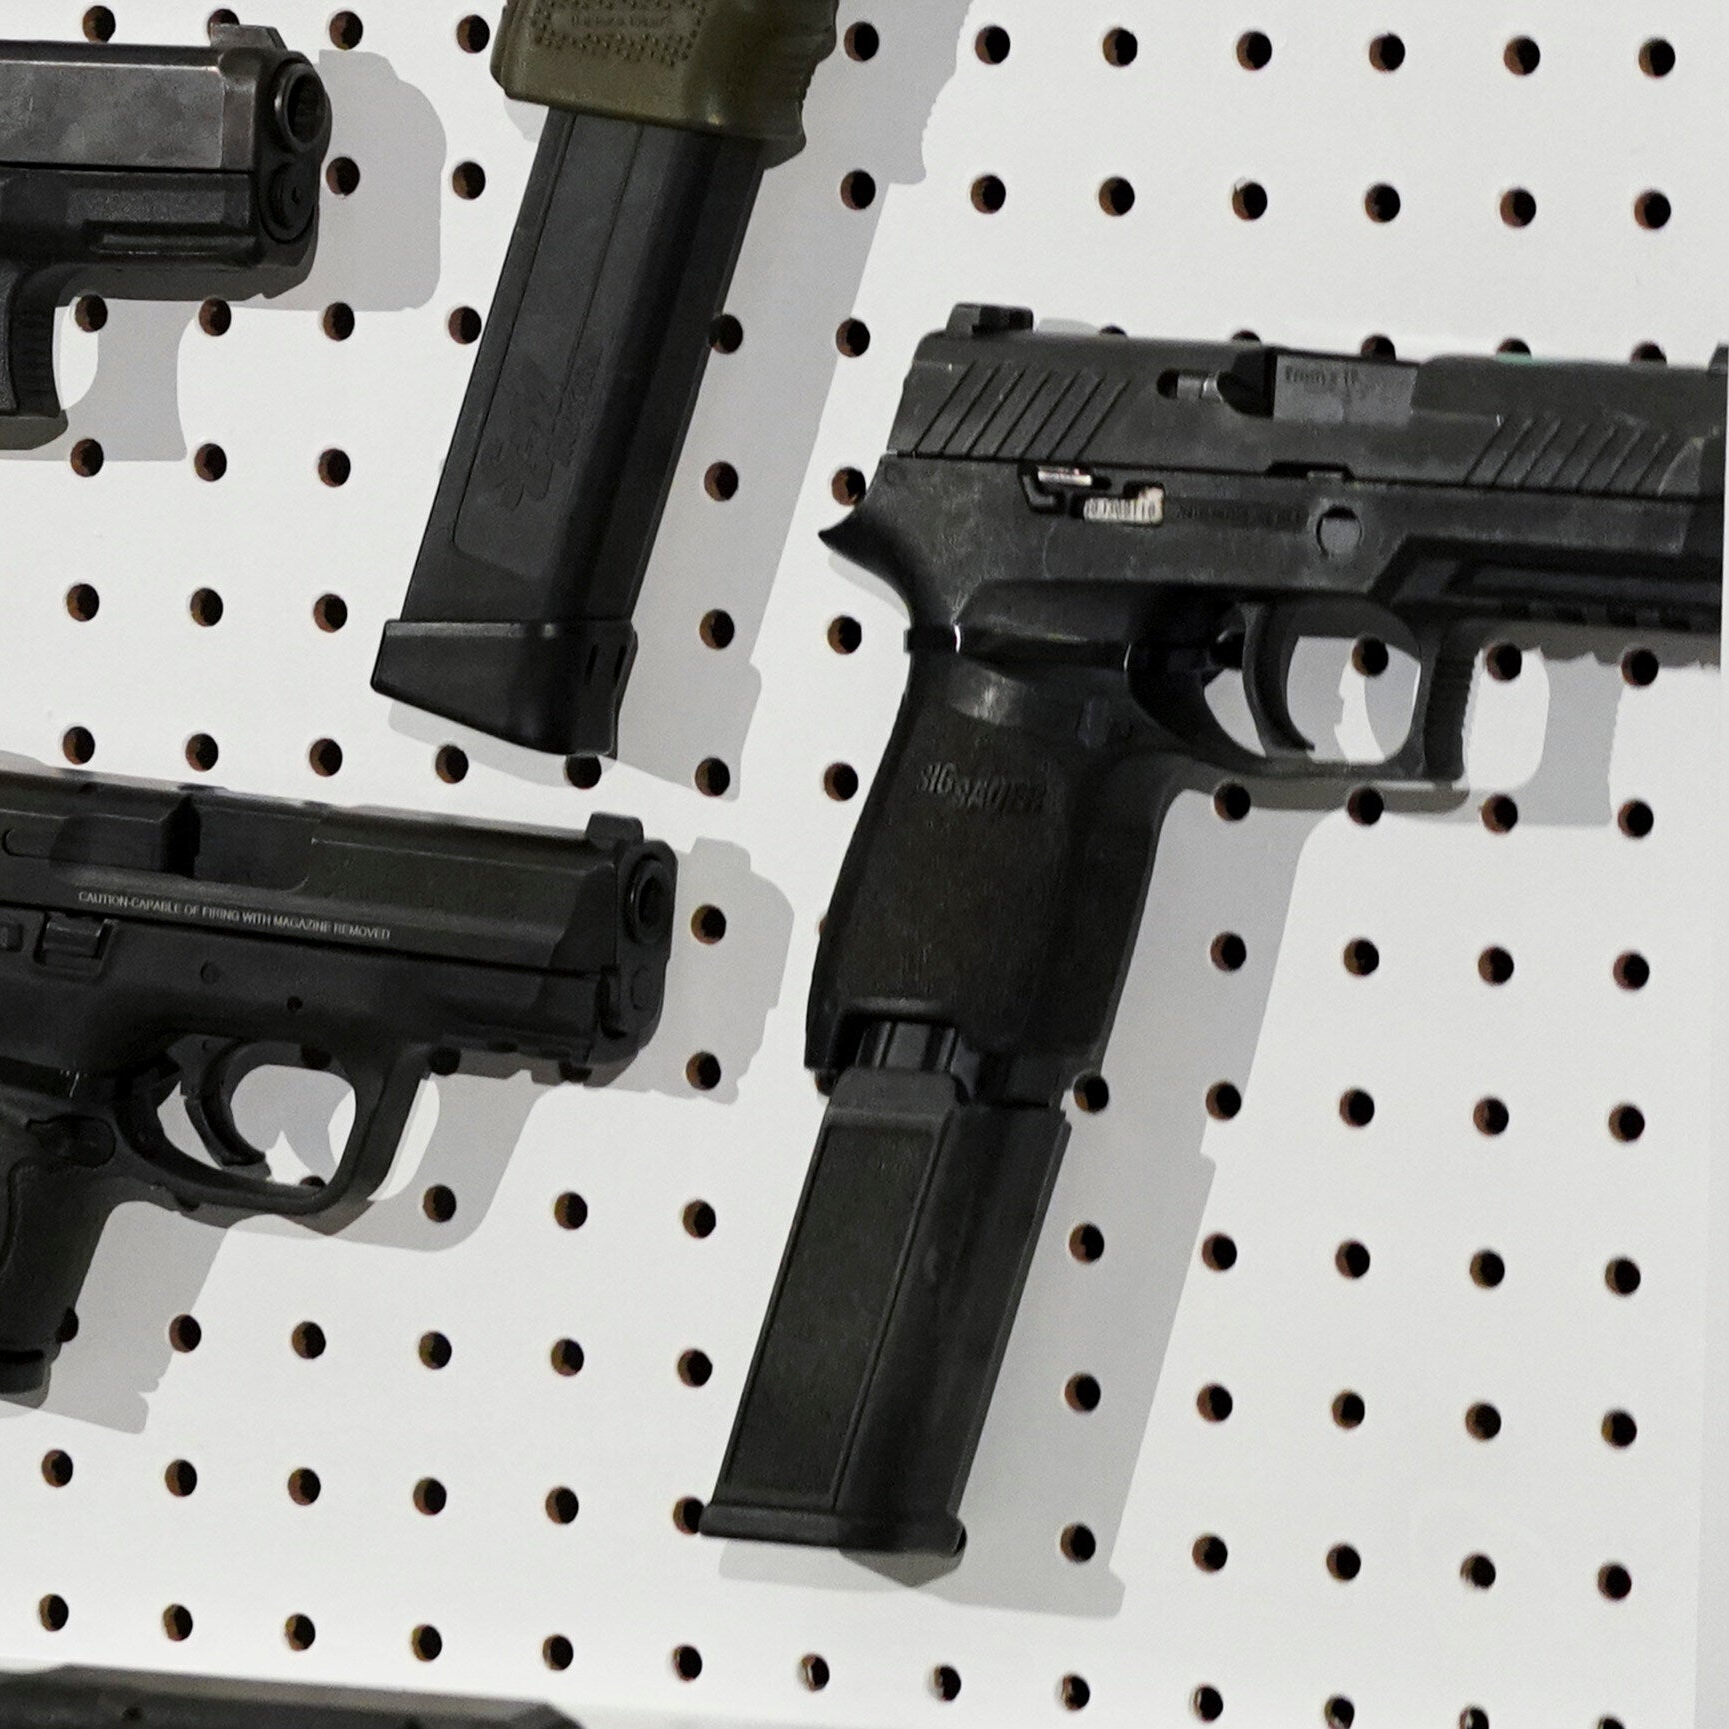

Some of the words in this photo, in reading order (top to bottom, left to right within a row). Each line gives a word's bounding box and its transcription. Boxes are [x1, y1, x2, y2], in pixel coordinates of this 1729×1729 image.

[917, 761, 957, 793] SIG
[78, 890, 180, 914] CAUTION-CAPABLE
[183, 902, 199, 917] OF
[201, 905, 240, 923] FIRING
[241, 910, 272, 927] WITH
[273, 913, 332, 934] MAGAZINE
[332, 918, 391, 941] REMOVED
